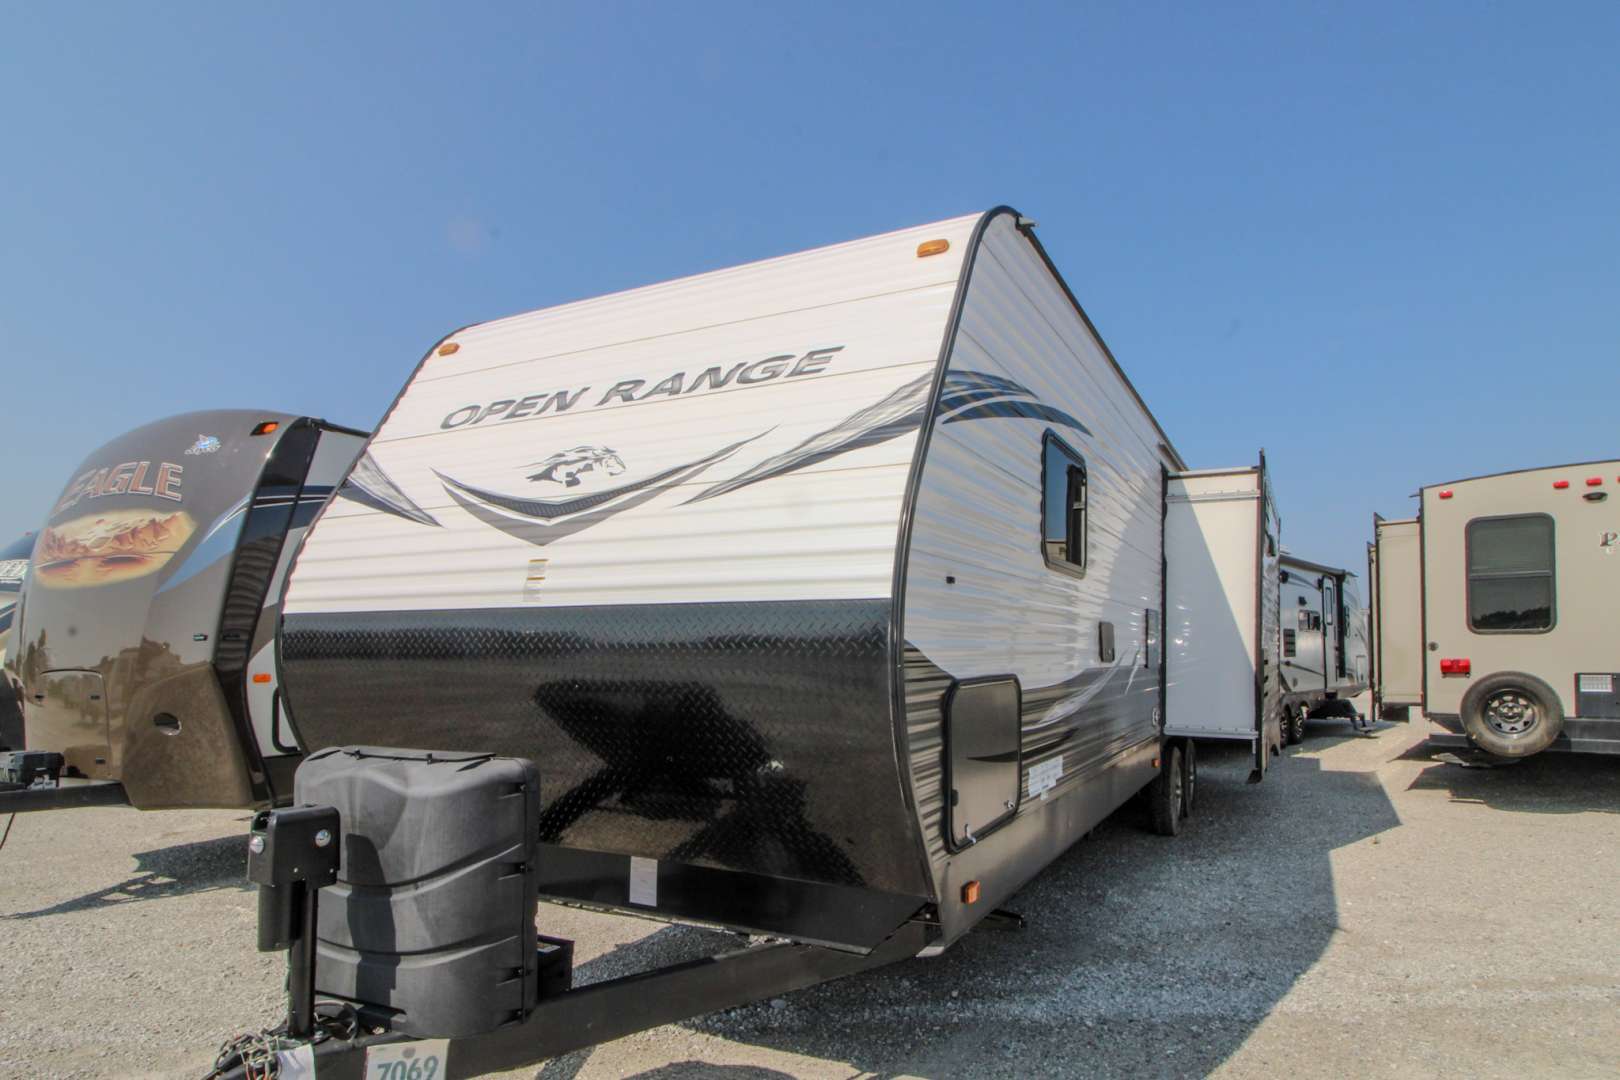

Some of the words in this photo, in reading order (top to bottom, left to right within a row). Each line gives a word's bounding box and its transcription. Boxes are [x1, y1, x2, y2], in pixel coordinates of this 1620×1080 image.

[440, 386, 591, 430] OPEN
[594, 345, 846, 407] RANGE
[52, 461, 184, 516] EAGLE
[377, 1055, 440, 1080] 7069
